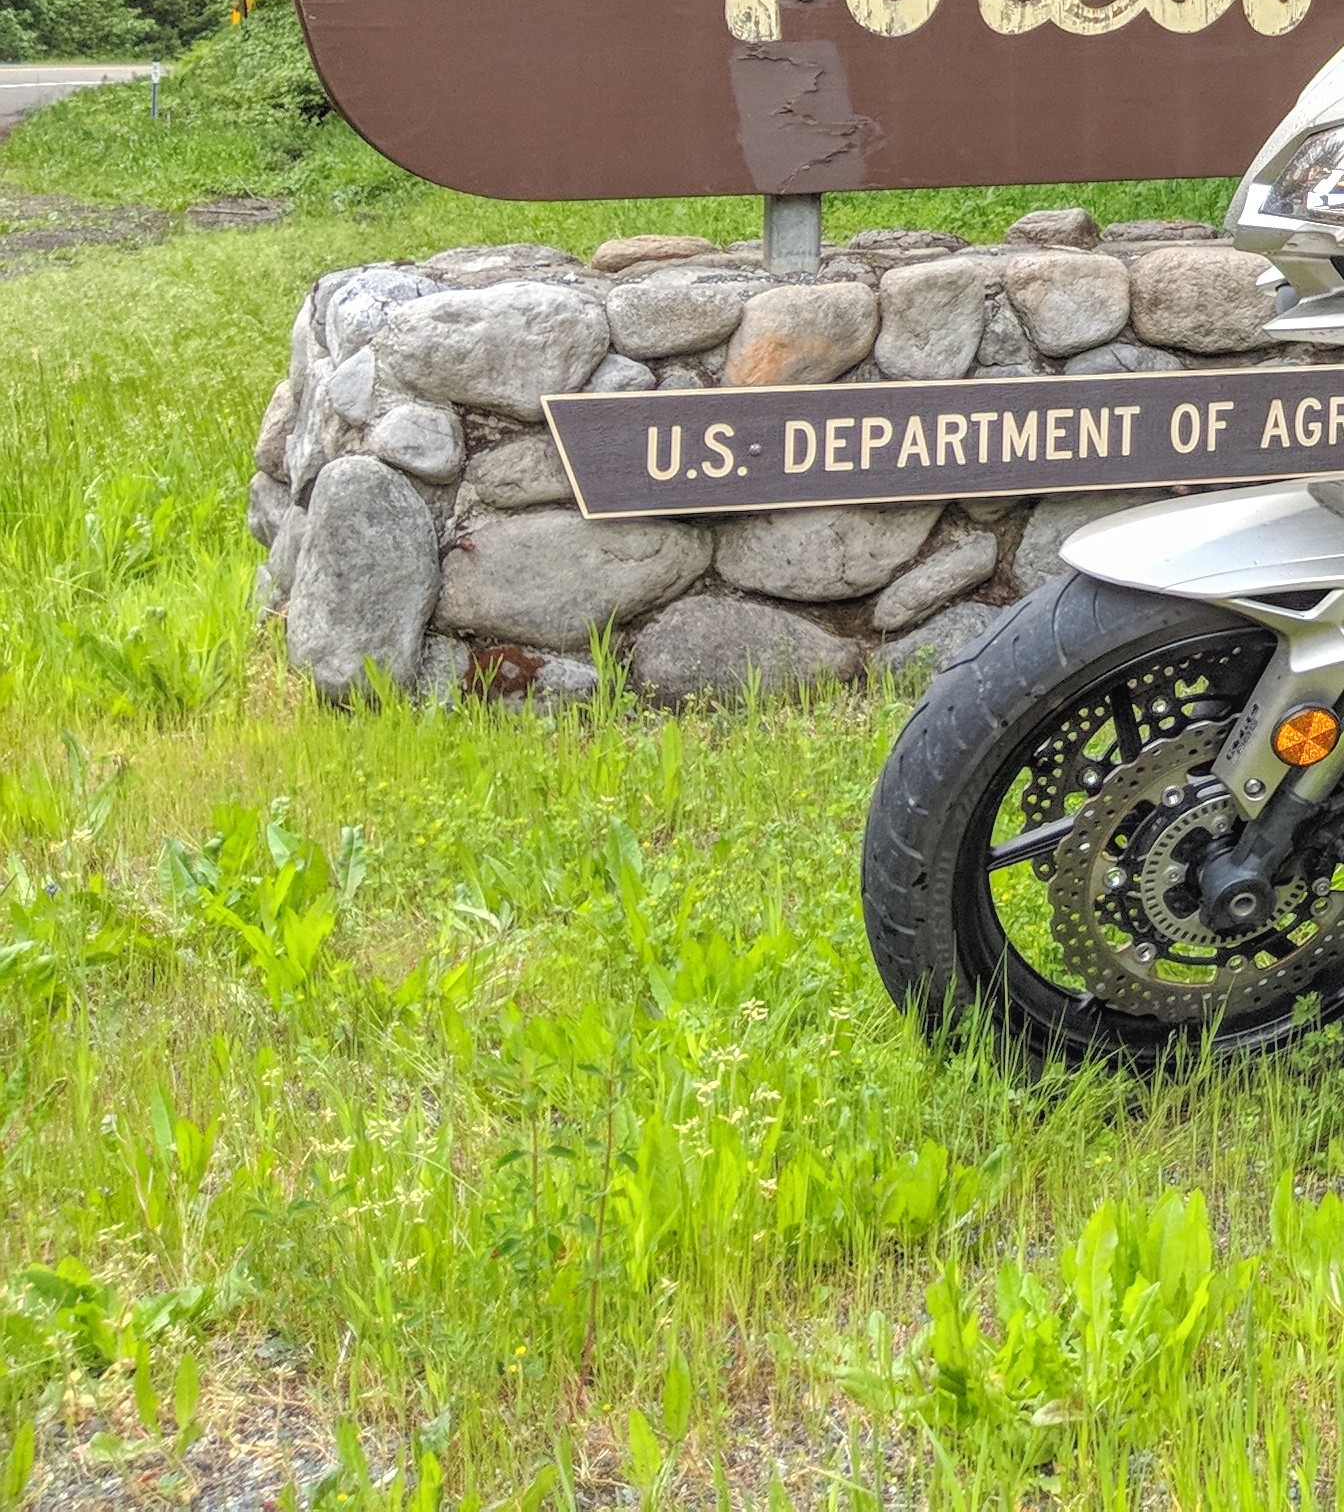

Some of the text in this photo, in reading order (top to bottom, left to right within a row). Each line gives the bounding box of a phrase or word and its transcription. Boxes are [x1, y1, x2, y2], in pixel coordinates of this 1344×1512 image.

[646, 422, 749, 482] U.S.
[783, 404, 1141, 475] DEPARTMENT
[1170, 399, 1235, 455] OF
